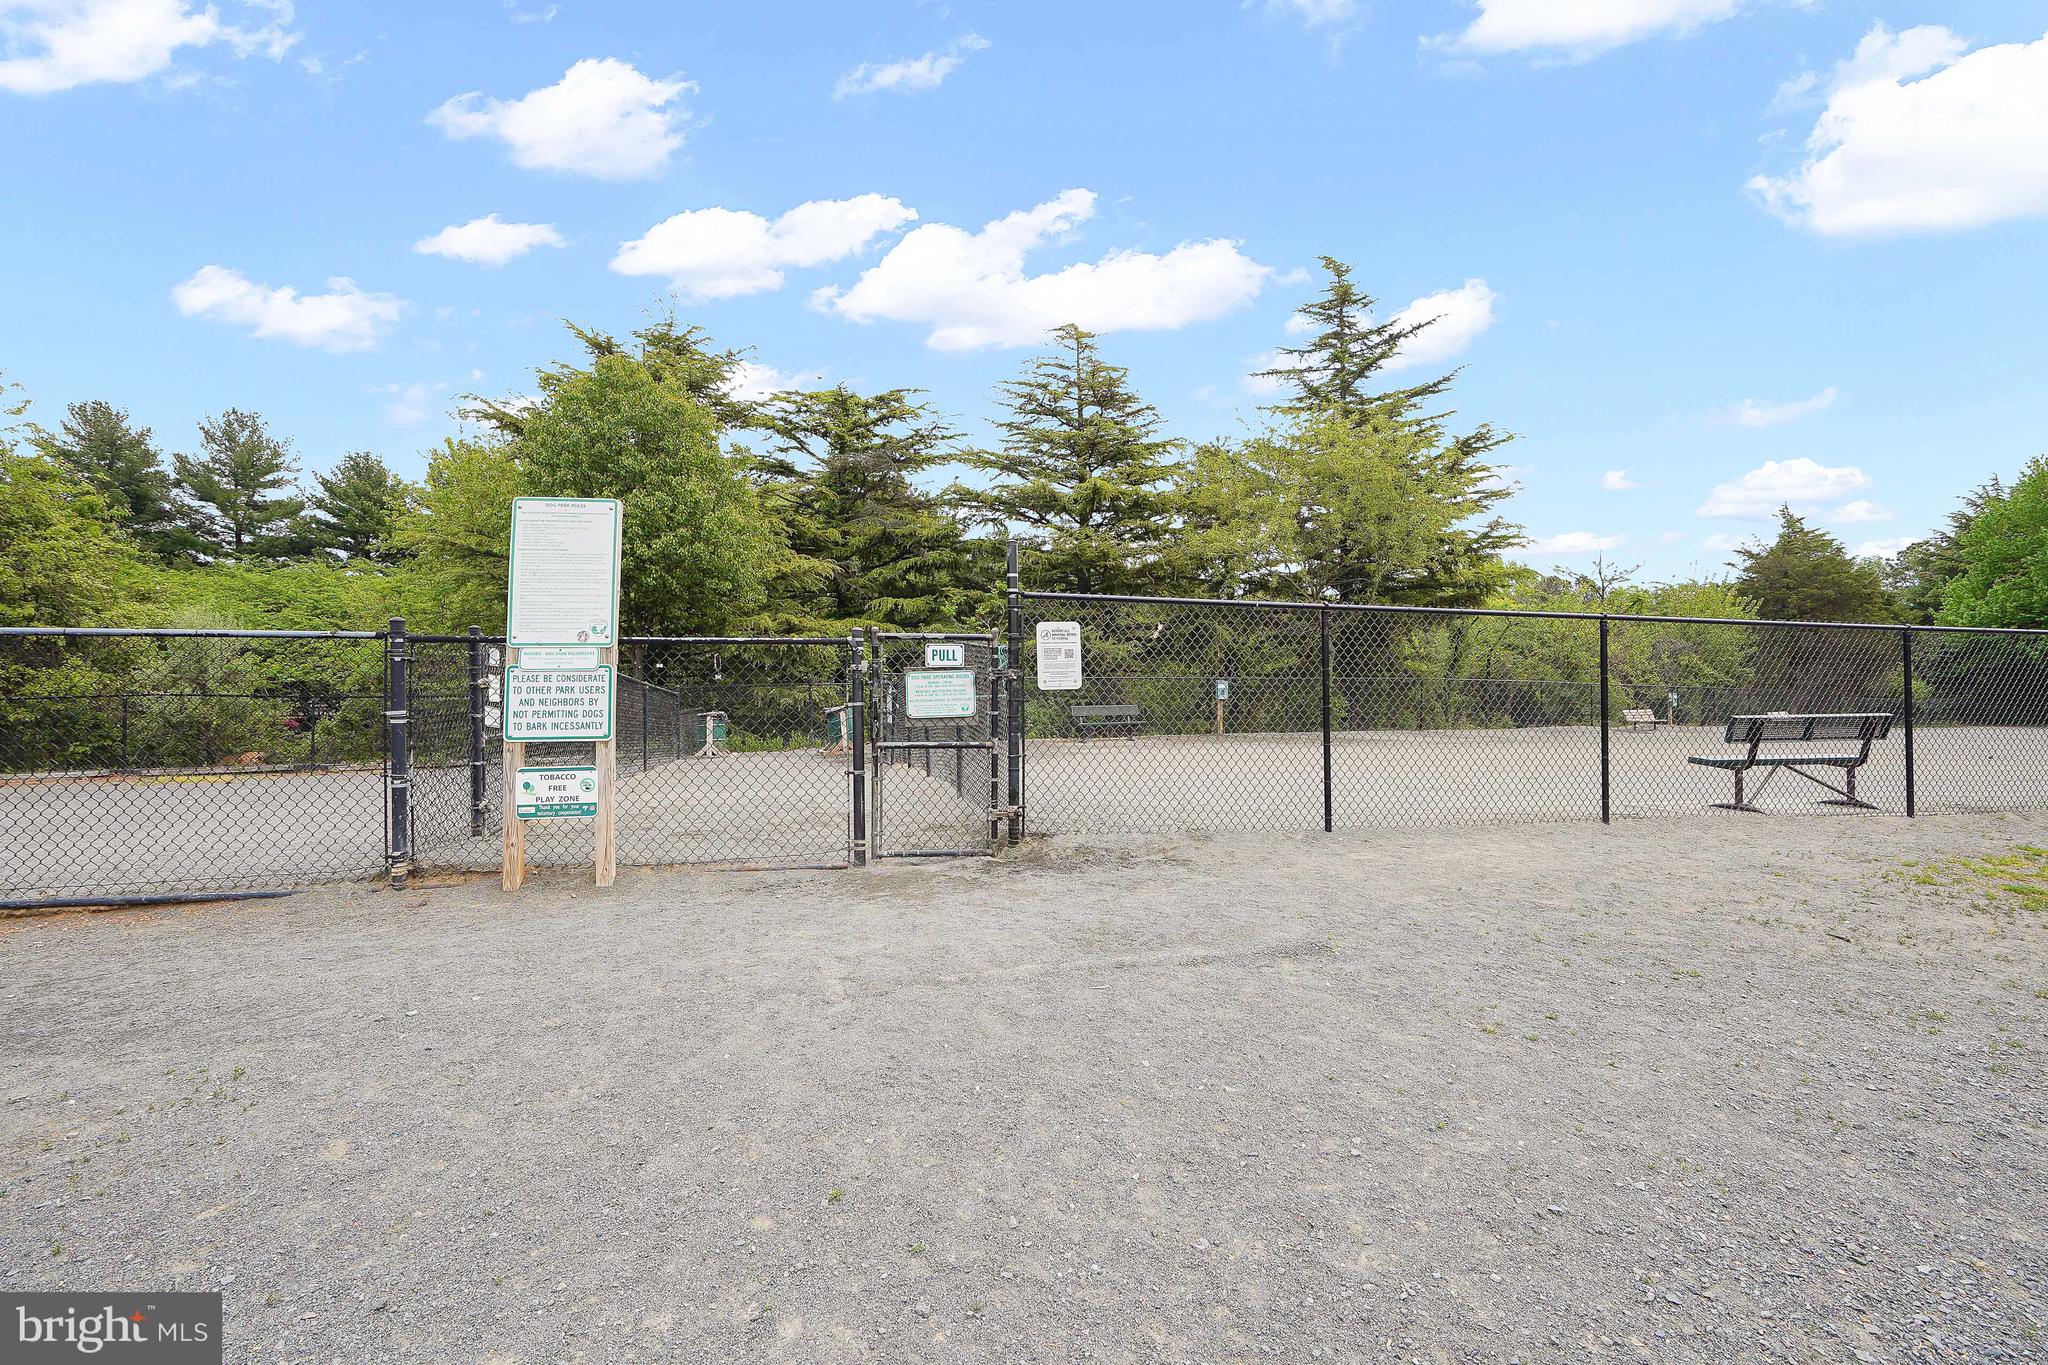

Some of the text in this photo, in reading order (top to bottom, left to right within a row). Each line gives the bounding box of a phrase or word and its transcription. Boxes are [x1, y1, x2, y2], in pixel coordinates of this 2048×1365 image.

[932, 649, 958, 662] PULL
[579, 686, 606, 694] USERS
[539, 698, 584, 706] NEIGHBORS
[513, 722, 603, 731] TO BARK INCESSANTLY
